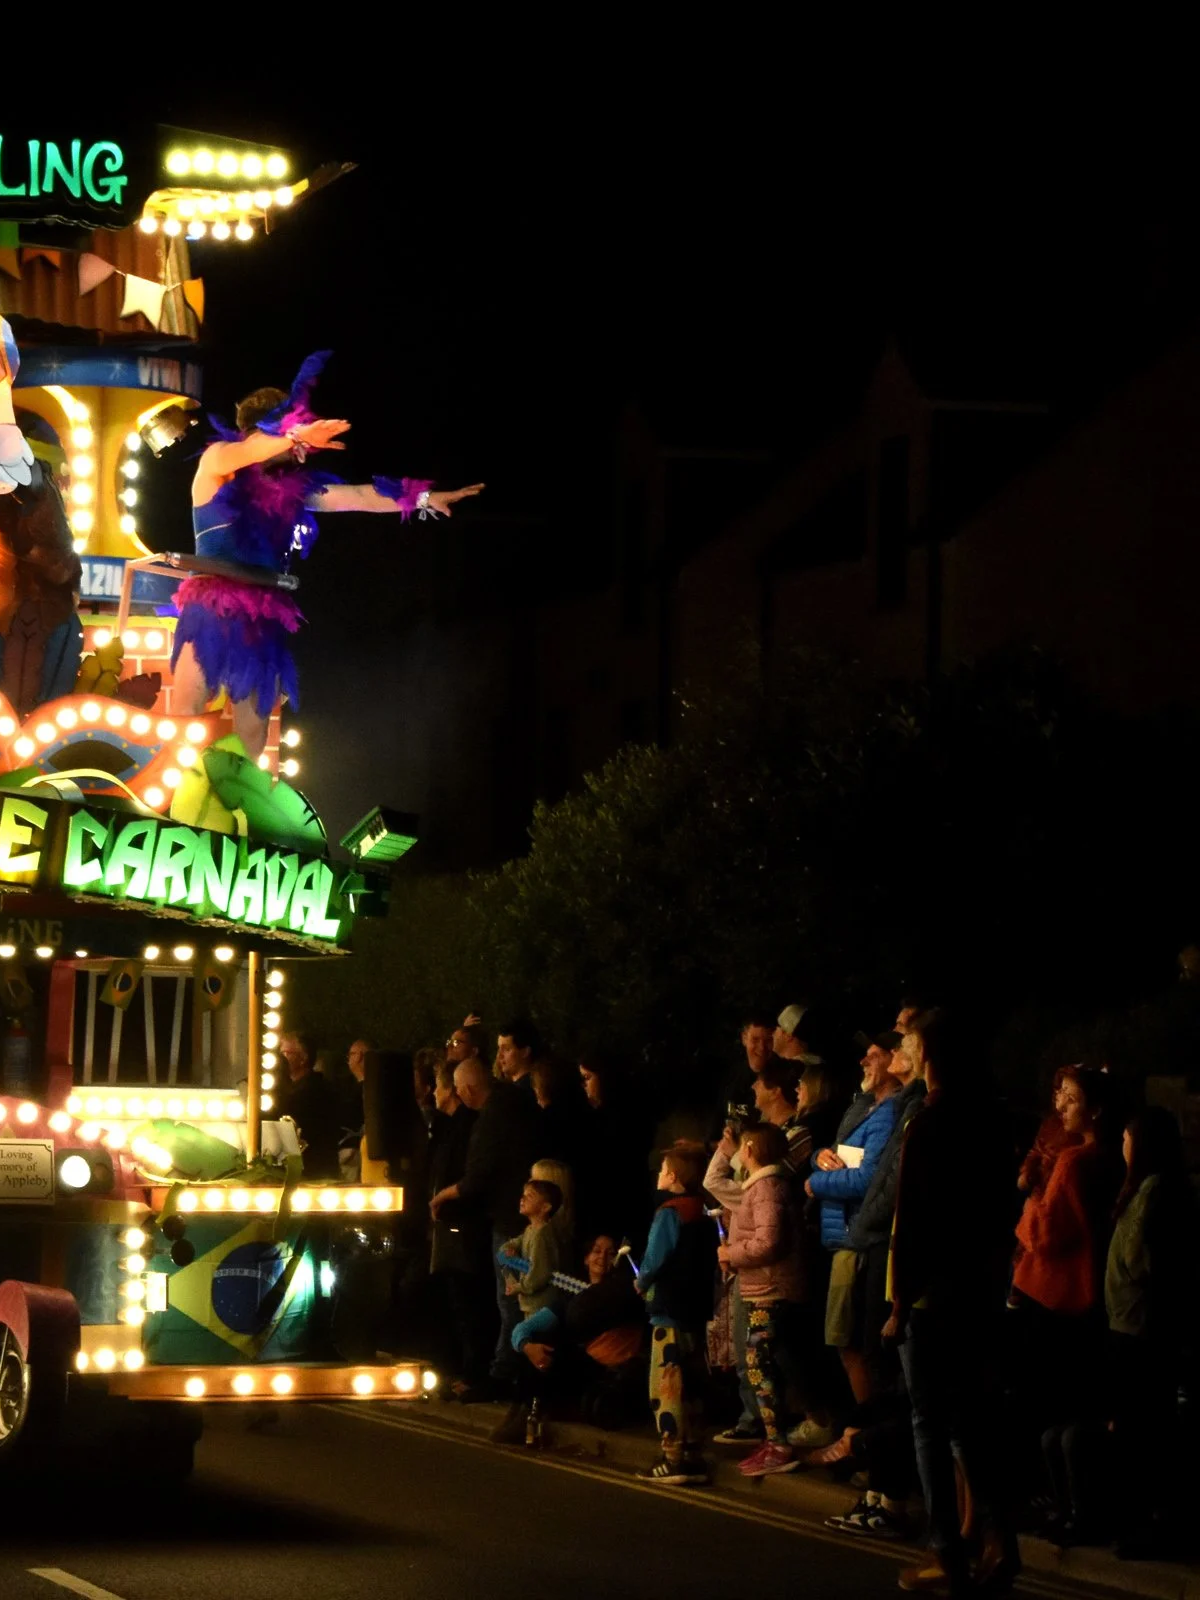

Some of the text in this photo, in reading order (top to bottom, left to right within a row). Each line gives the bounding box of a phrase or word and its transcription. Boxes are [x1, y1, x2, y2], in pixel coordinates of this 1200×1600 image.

[63, 808, 341, 938] CARNAVAL
[0, 1149, 33, 1161] Loving
[26, 1162, 38, 1172] of
[4, 1174, 48, 1189] Appleby
